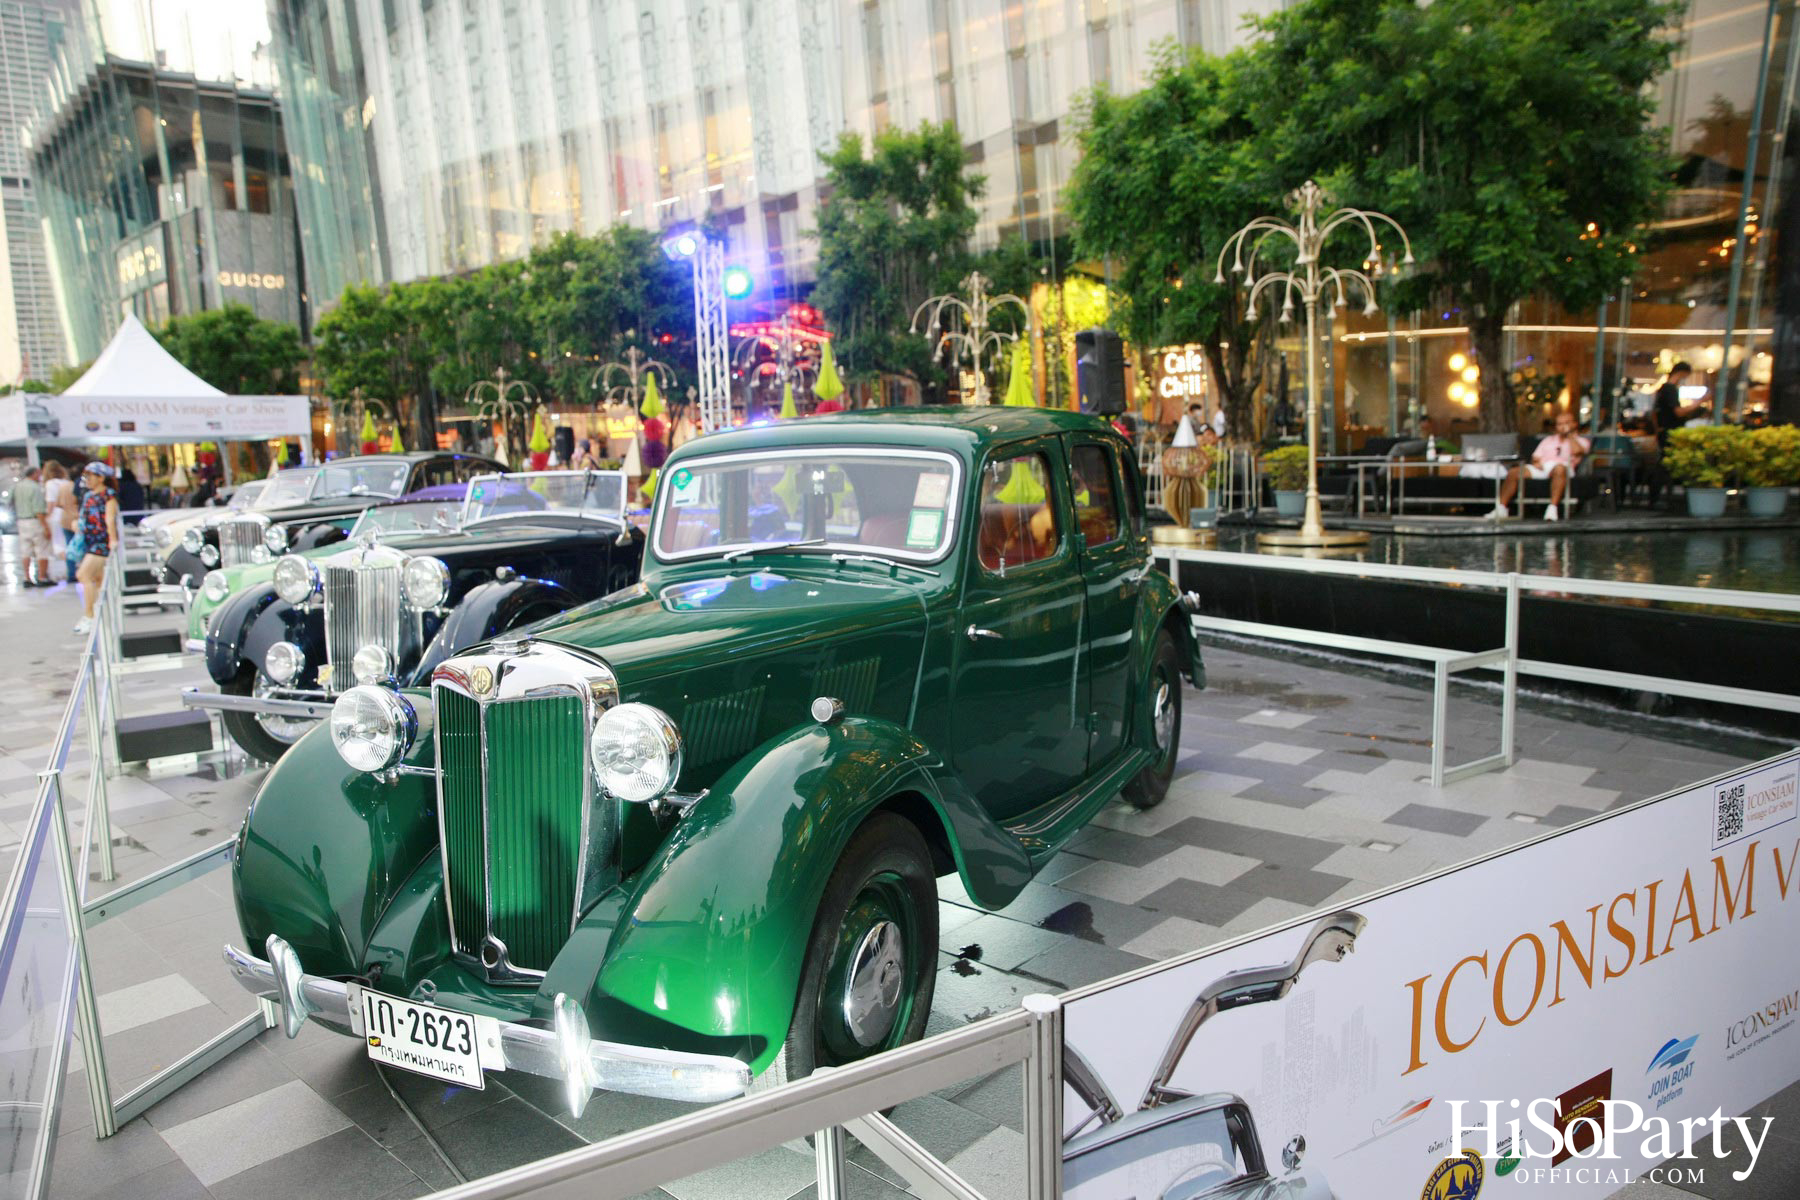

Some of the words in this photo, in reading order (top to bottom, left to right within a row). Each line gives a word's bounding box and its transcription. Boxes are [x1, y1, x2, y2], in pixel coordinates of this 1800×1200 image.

[217, 271, 285, 289] GUCCI
[81, 402, 168, 416] ICONSIAM
[172, 404, 222, 418] Vintage
[226, 404, 248, 415] Car
[252, 403, 286, 415] Show
[1747, 781, 1795, 811] ICONSIAM
[1401, 841, 1760, 1076] ICONSIAM
[1773, 838, 1800, 902] V
[1726, 990, 1799, 1049] ICONSIAM
[380, 1045, 465, 1077] กรุงเทพมหานคร
[1648, 1075, 1671, 1099] JOIN
[1671, 1061, 1695, 1086] BOAT
[1656, 1087, 1684, 1111] platform
